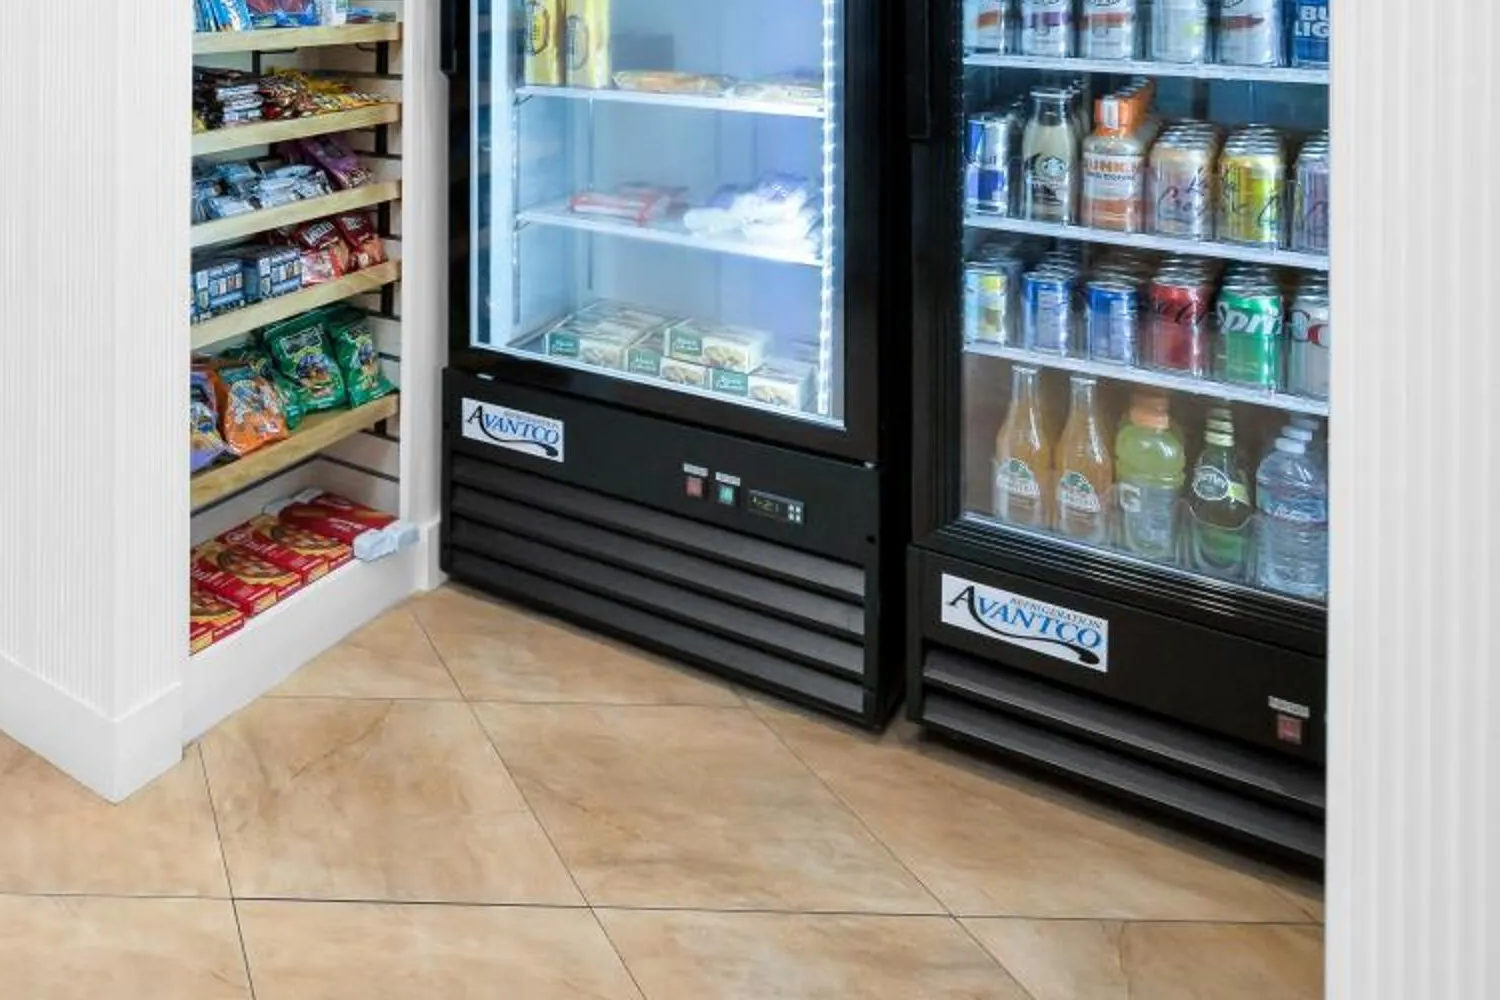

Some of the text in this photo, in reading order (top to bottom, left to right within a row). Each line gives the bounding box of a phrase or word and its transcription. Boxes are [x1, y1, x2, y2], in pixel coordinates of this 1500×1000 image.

[1301, 5, 1329, 21] BU
[1295, 21, 1329, 38] LIG
[949, 585, 1102, 649] AVANTCO
